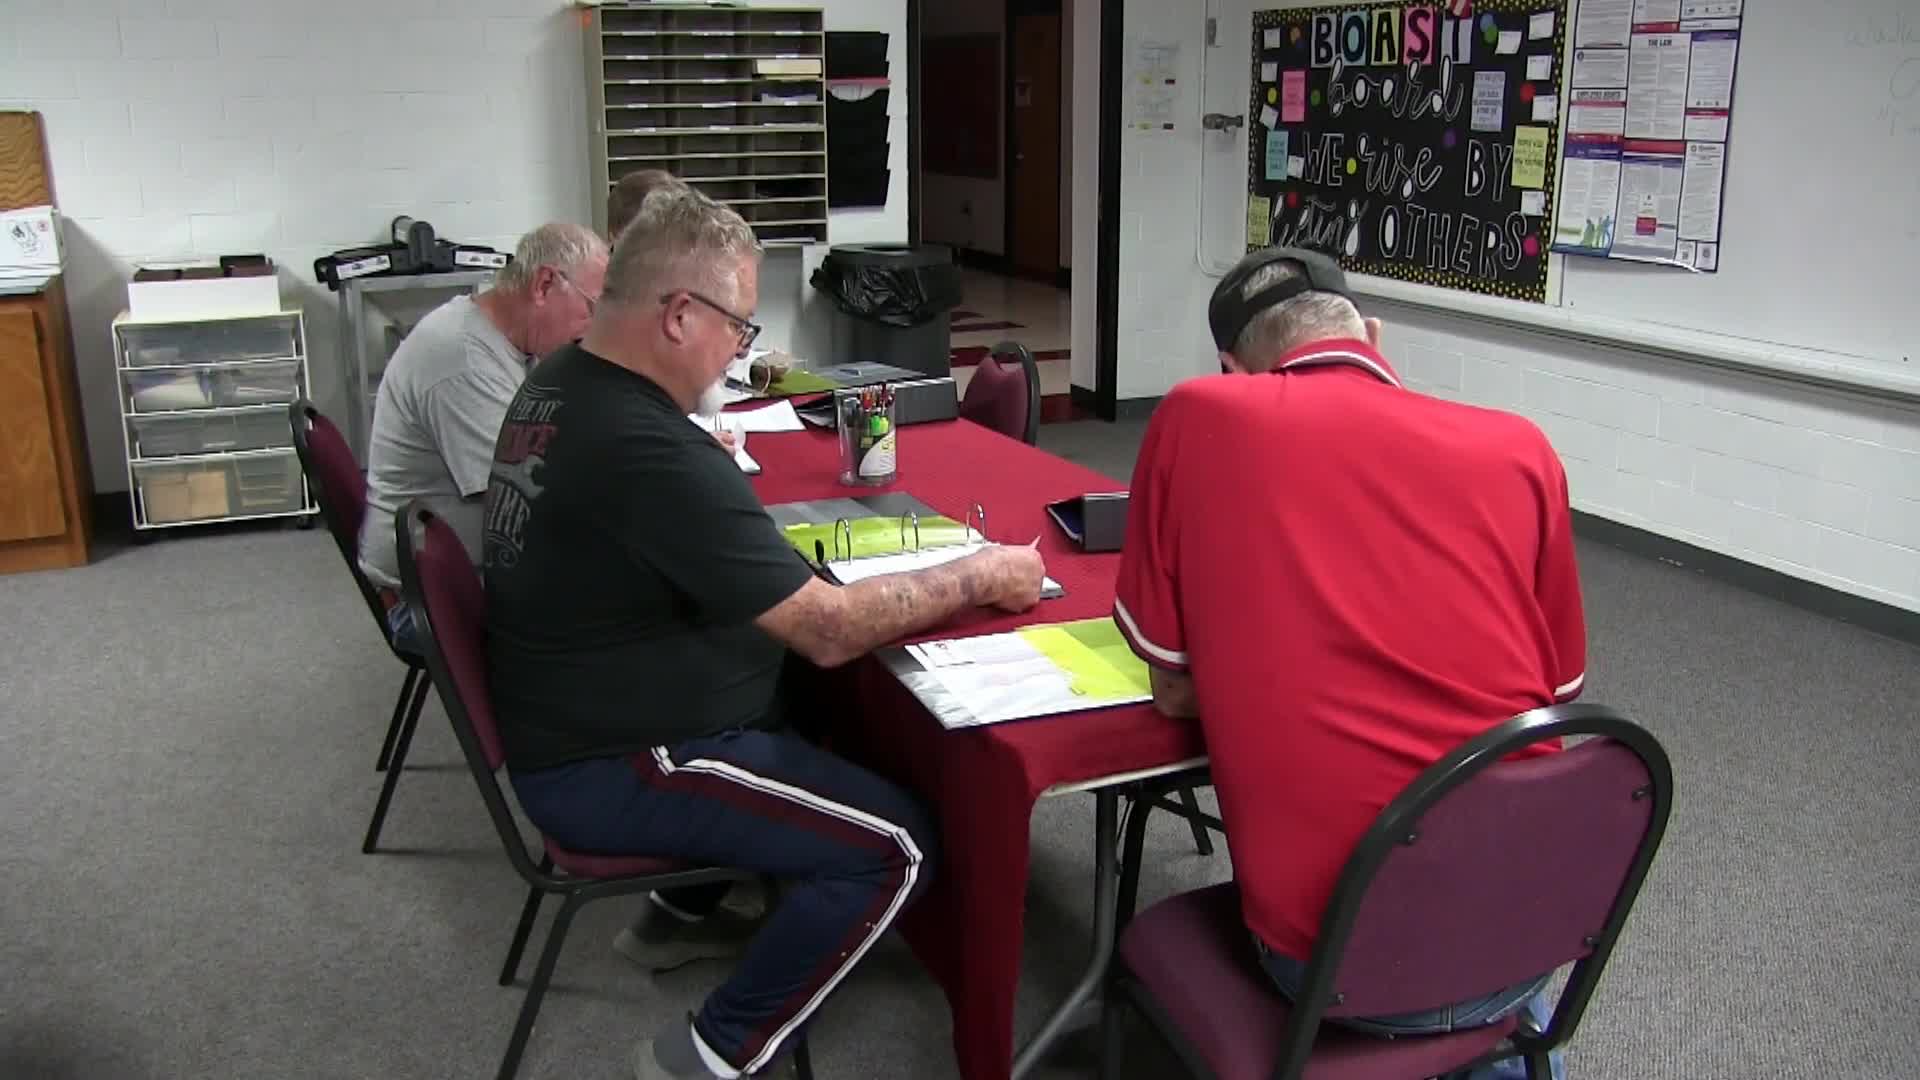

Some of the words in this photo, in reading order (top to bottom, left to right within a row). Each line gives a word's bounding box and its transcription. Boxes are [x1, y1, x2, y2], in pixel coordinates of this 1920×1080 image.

[1315, 10, 1466, 64] BOAST
[1329, 54, 1464, 122] board
[1303, 132, 1344, 186] WE
[1357, 133, 1443, 200] rise
[1465, 139, 1512, 201] BY
[1379, 203, 1527, 280] OTHERS
